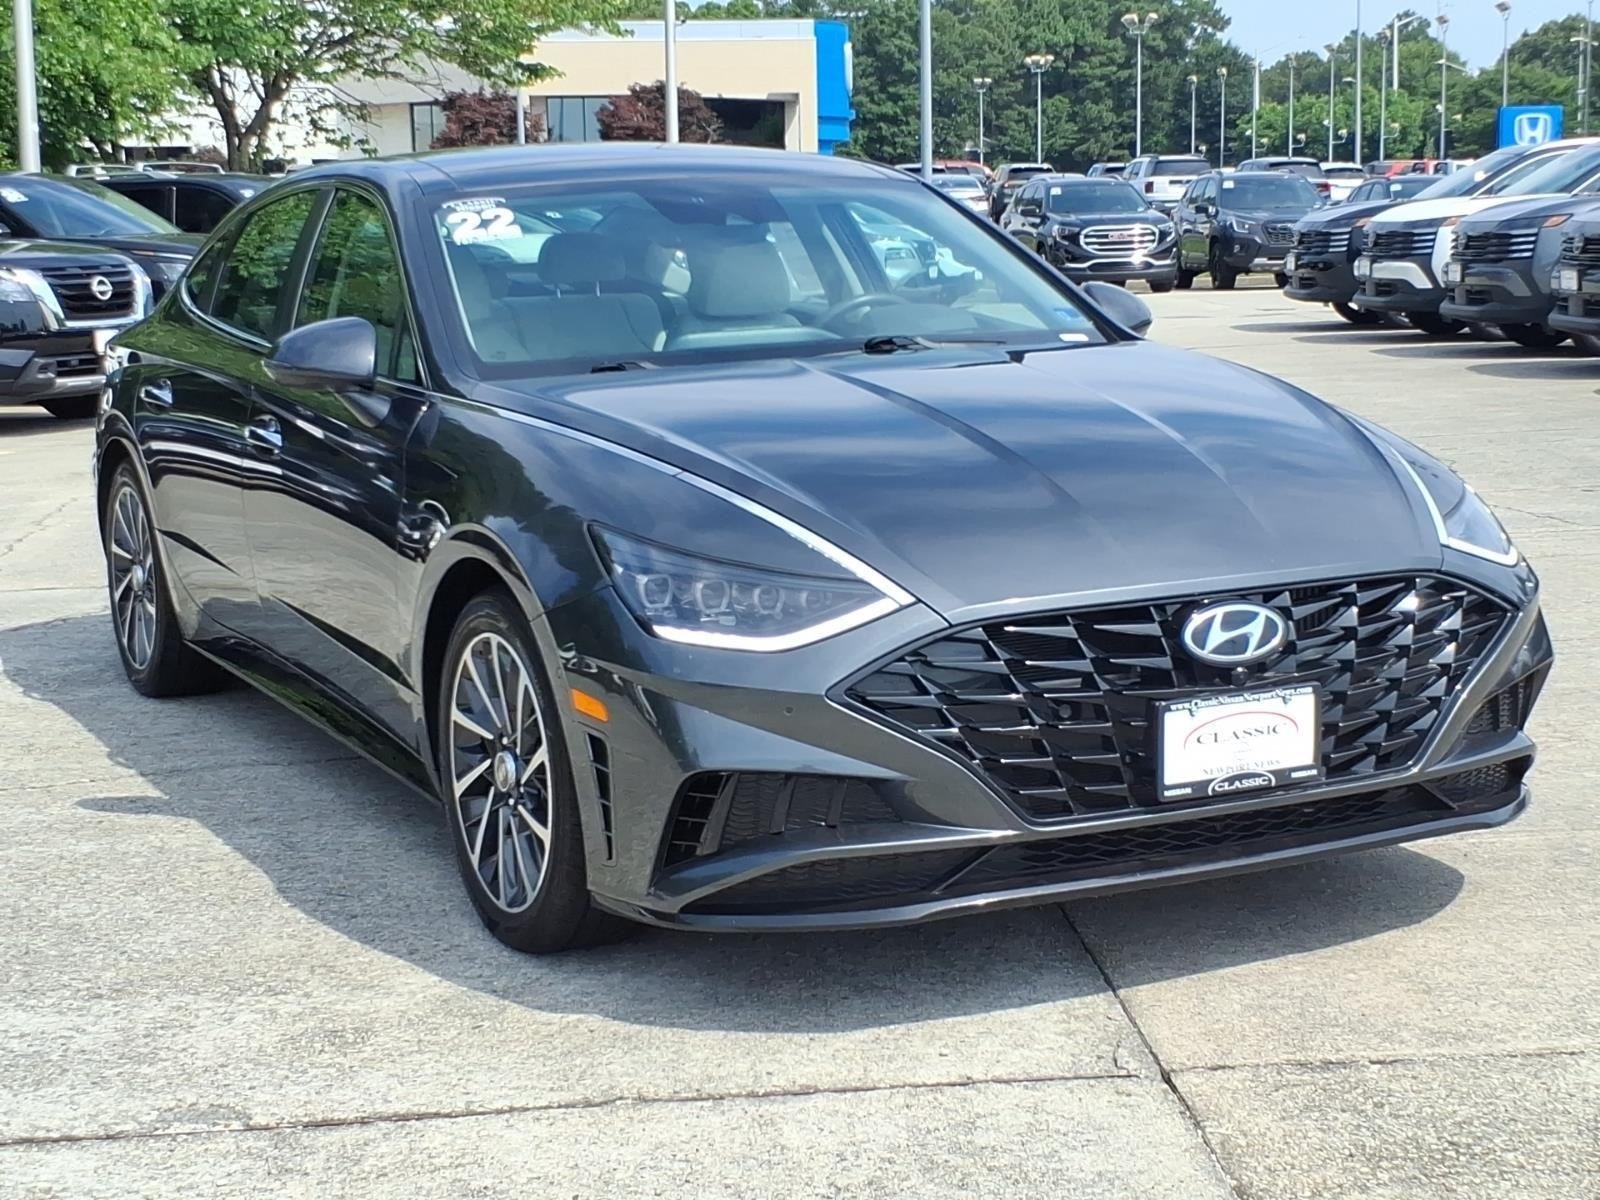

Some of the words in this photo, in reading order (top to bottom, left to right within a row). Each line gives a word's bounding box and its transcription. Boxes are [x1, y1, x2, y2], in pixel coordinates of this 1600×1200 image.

[447, 208, 523, 242] 22
[1196, 724, 1281, 744] CLASSIC
[1214, 775, 1270, 792] CLASSIC
